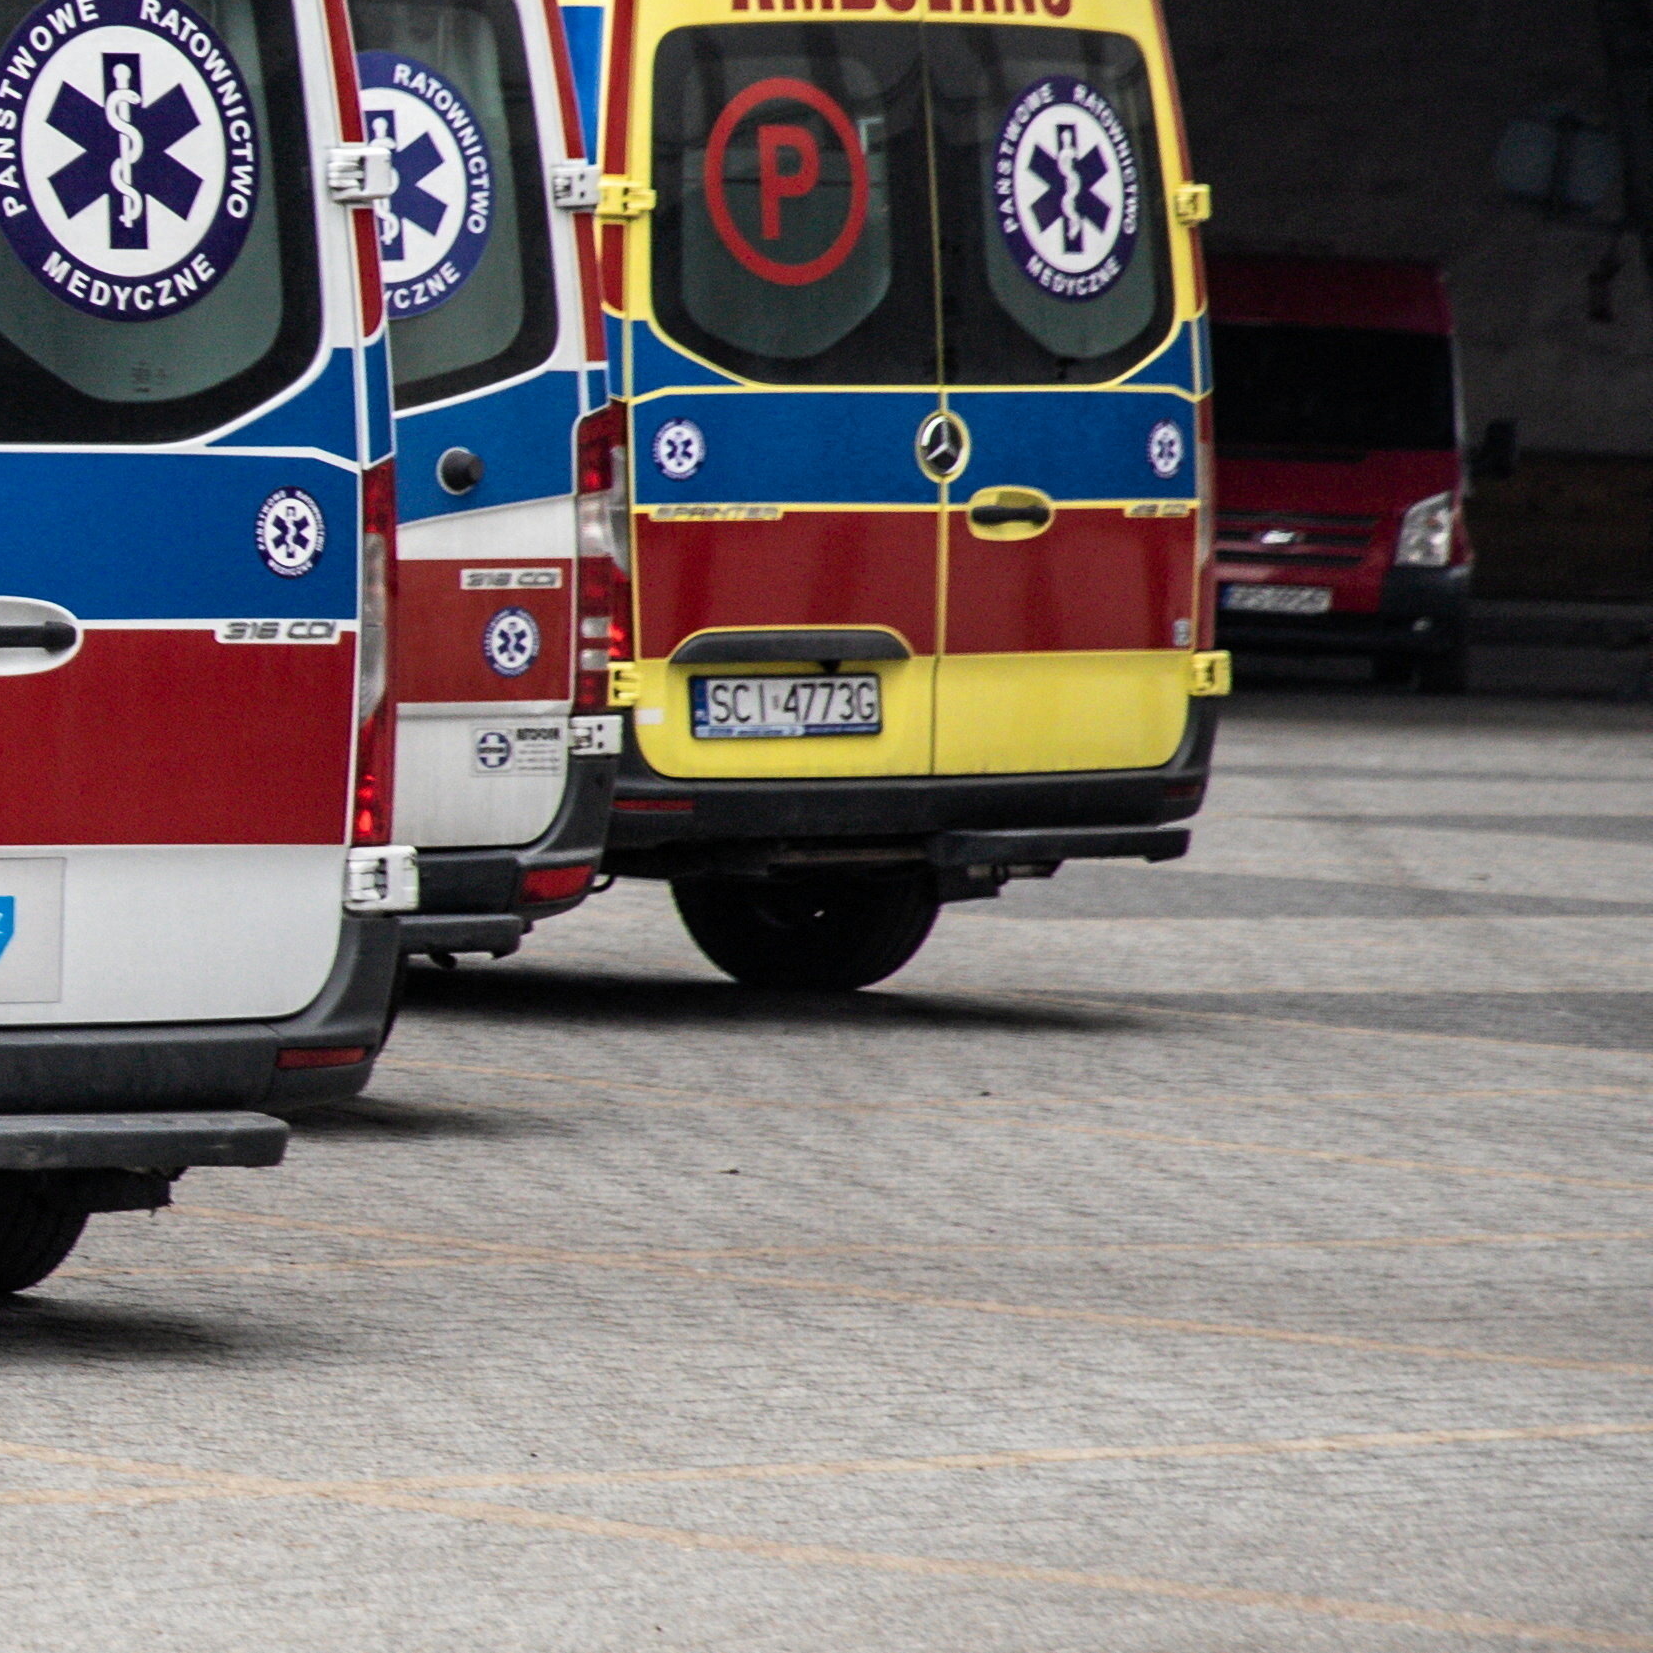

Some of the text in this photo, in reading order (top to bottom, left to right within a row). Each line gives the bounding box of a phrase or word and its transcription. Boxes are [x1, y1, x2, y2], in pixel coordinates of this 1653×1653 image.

[393, 63, 491, 234] RATOWNICTWO
[1073, 84, 1139, 234] RATOWNICTWO
[759, 124, 820, 240] P
[42, 251, 216, 311] MEDYCZNE
[383, 261, 461, 309] CZNE
[1026, 254, 1122, 295] MEDYCZNE
[288, 621, 336, 639] CDI
[711, 682, 876, 723] SCI 4773G
